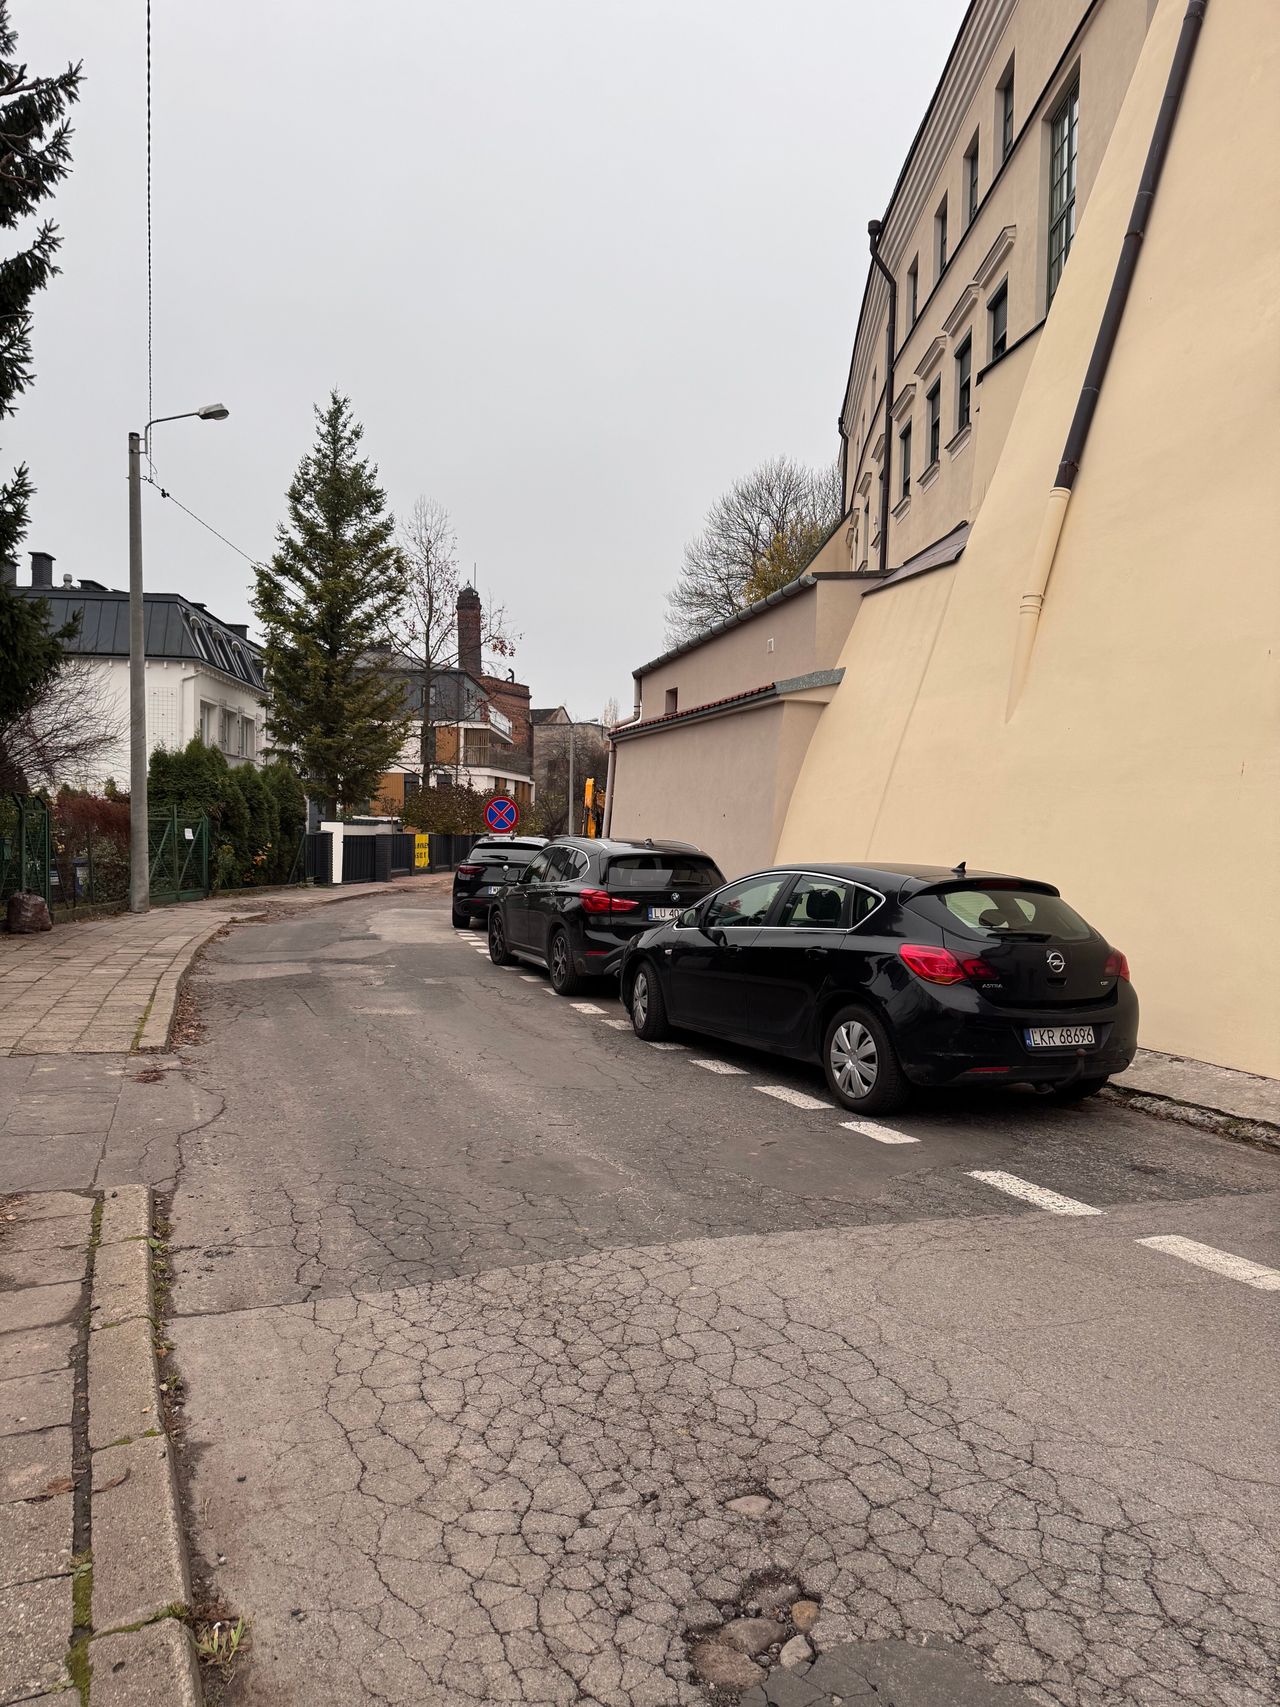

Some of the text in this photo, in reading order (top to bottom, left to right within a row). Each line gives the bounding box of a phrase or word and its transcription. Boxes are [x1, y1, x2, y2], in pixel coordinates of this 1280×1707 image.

[654, 908, 666, 918] LU
[1031, 1029, 1056, 1045] LKR
[1060, 1027, 1093, 1044] 68696
